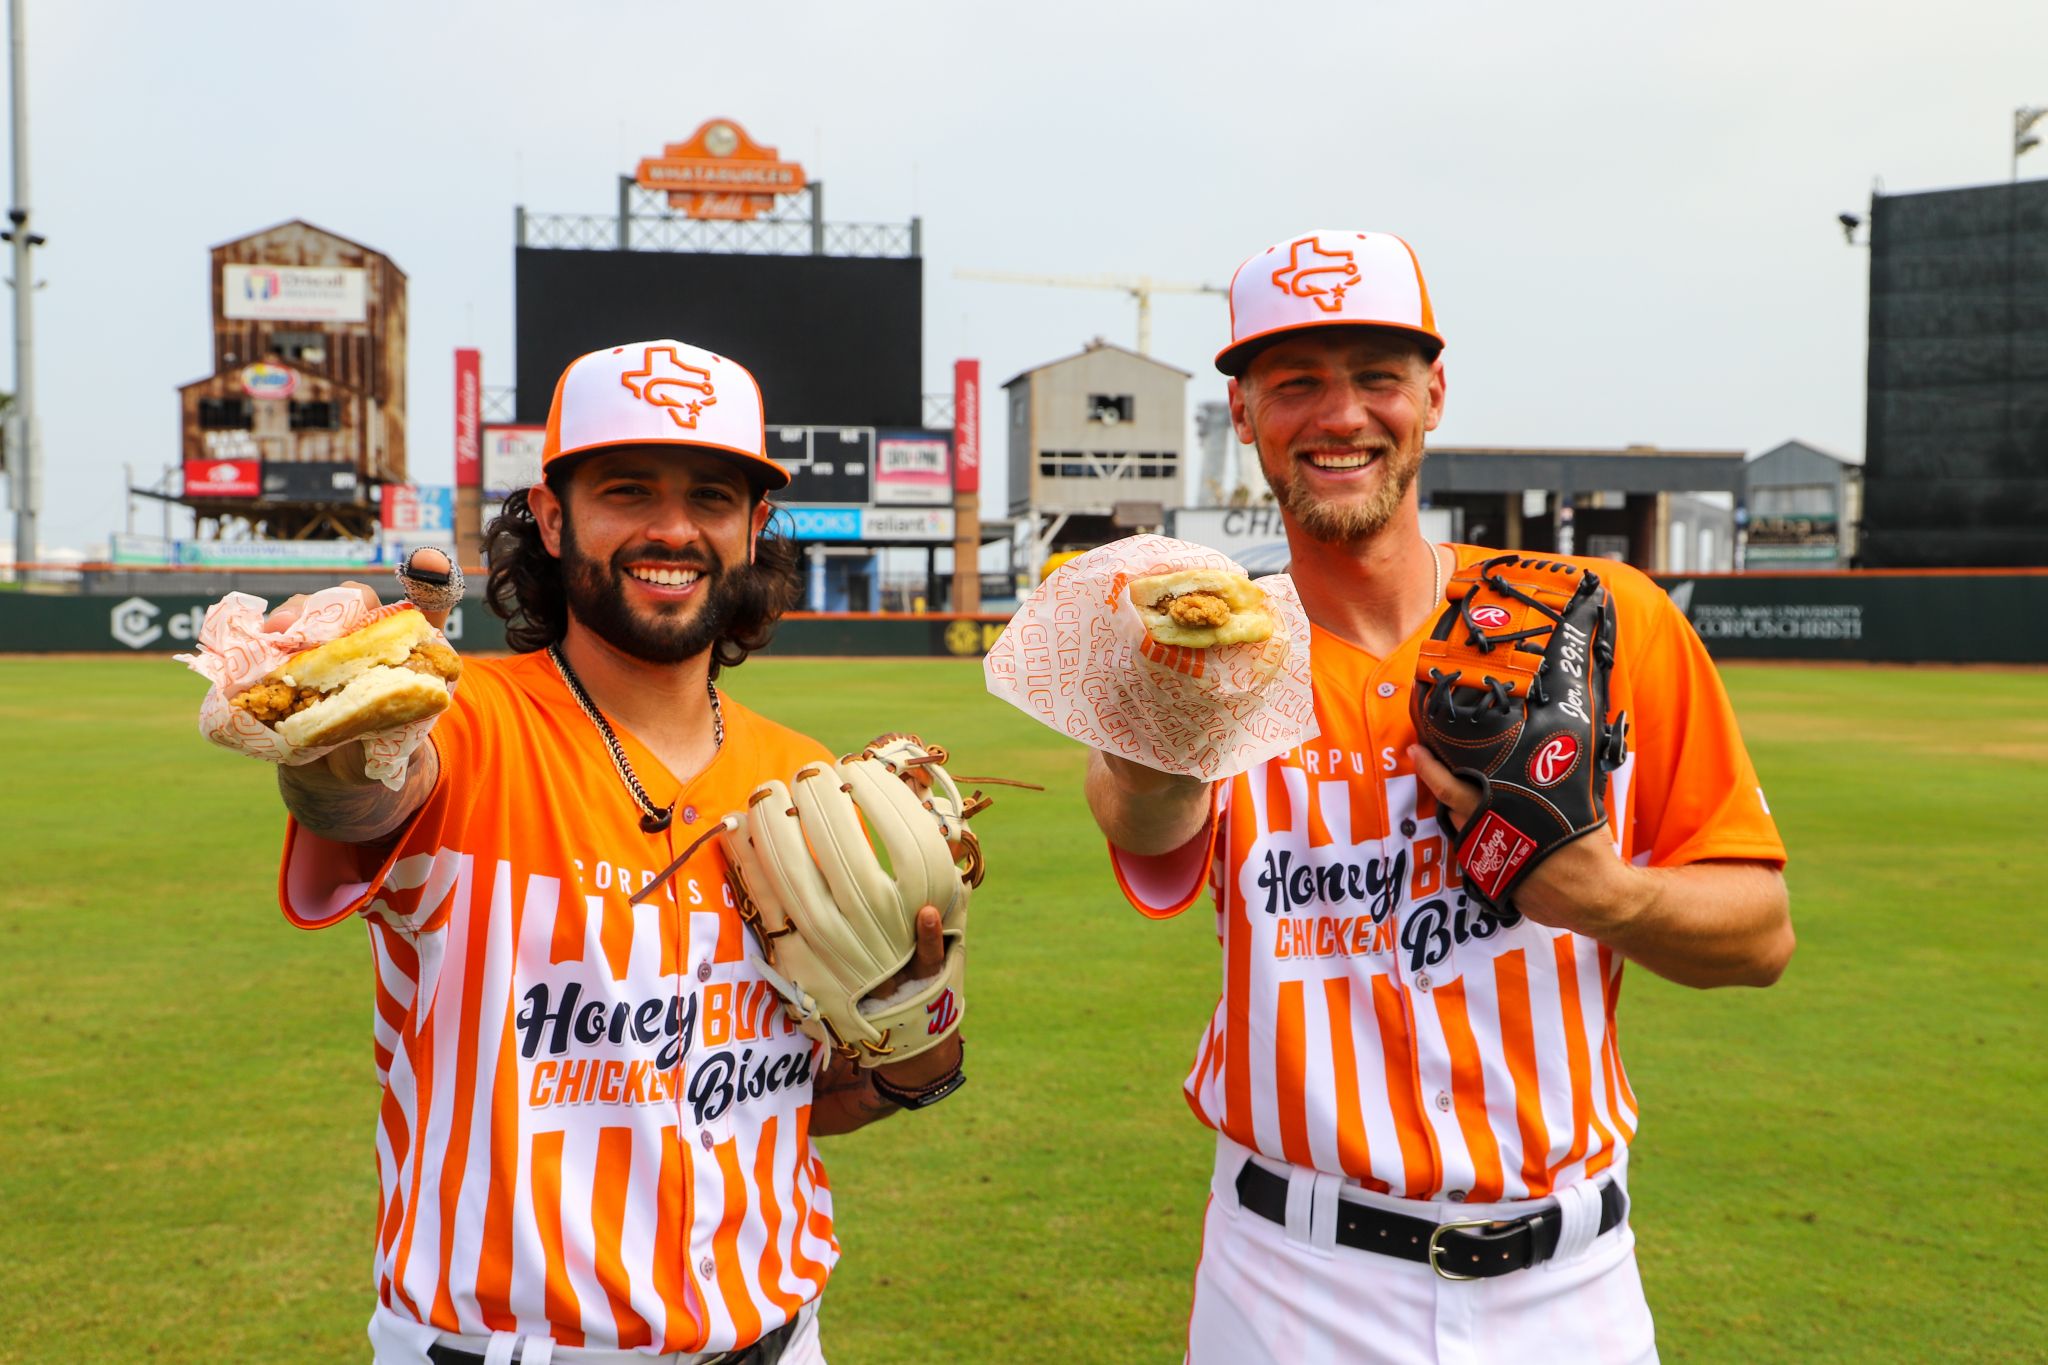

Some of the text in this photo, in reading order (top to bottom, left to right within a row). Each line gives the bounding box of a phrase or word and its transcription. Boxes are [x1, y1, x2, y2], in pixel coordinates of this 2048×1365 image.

[650, 166, 794, 184] WHATABURGER
[395, 504, 442, 530] ER
[867, 516, 925, 532] reliant
[1257, 848, 1407, 924] Honey
[516, 982, 698, 1071] Honey
